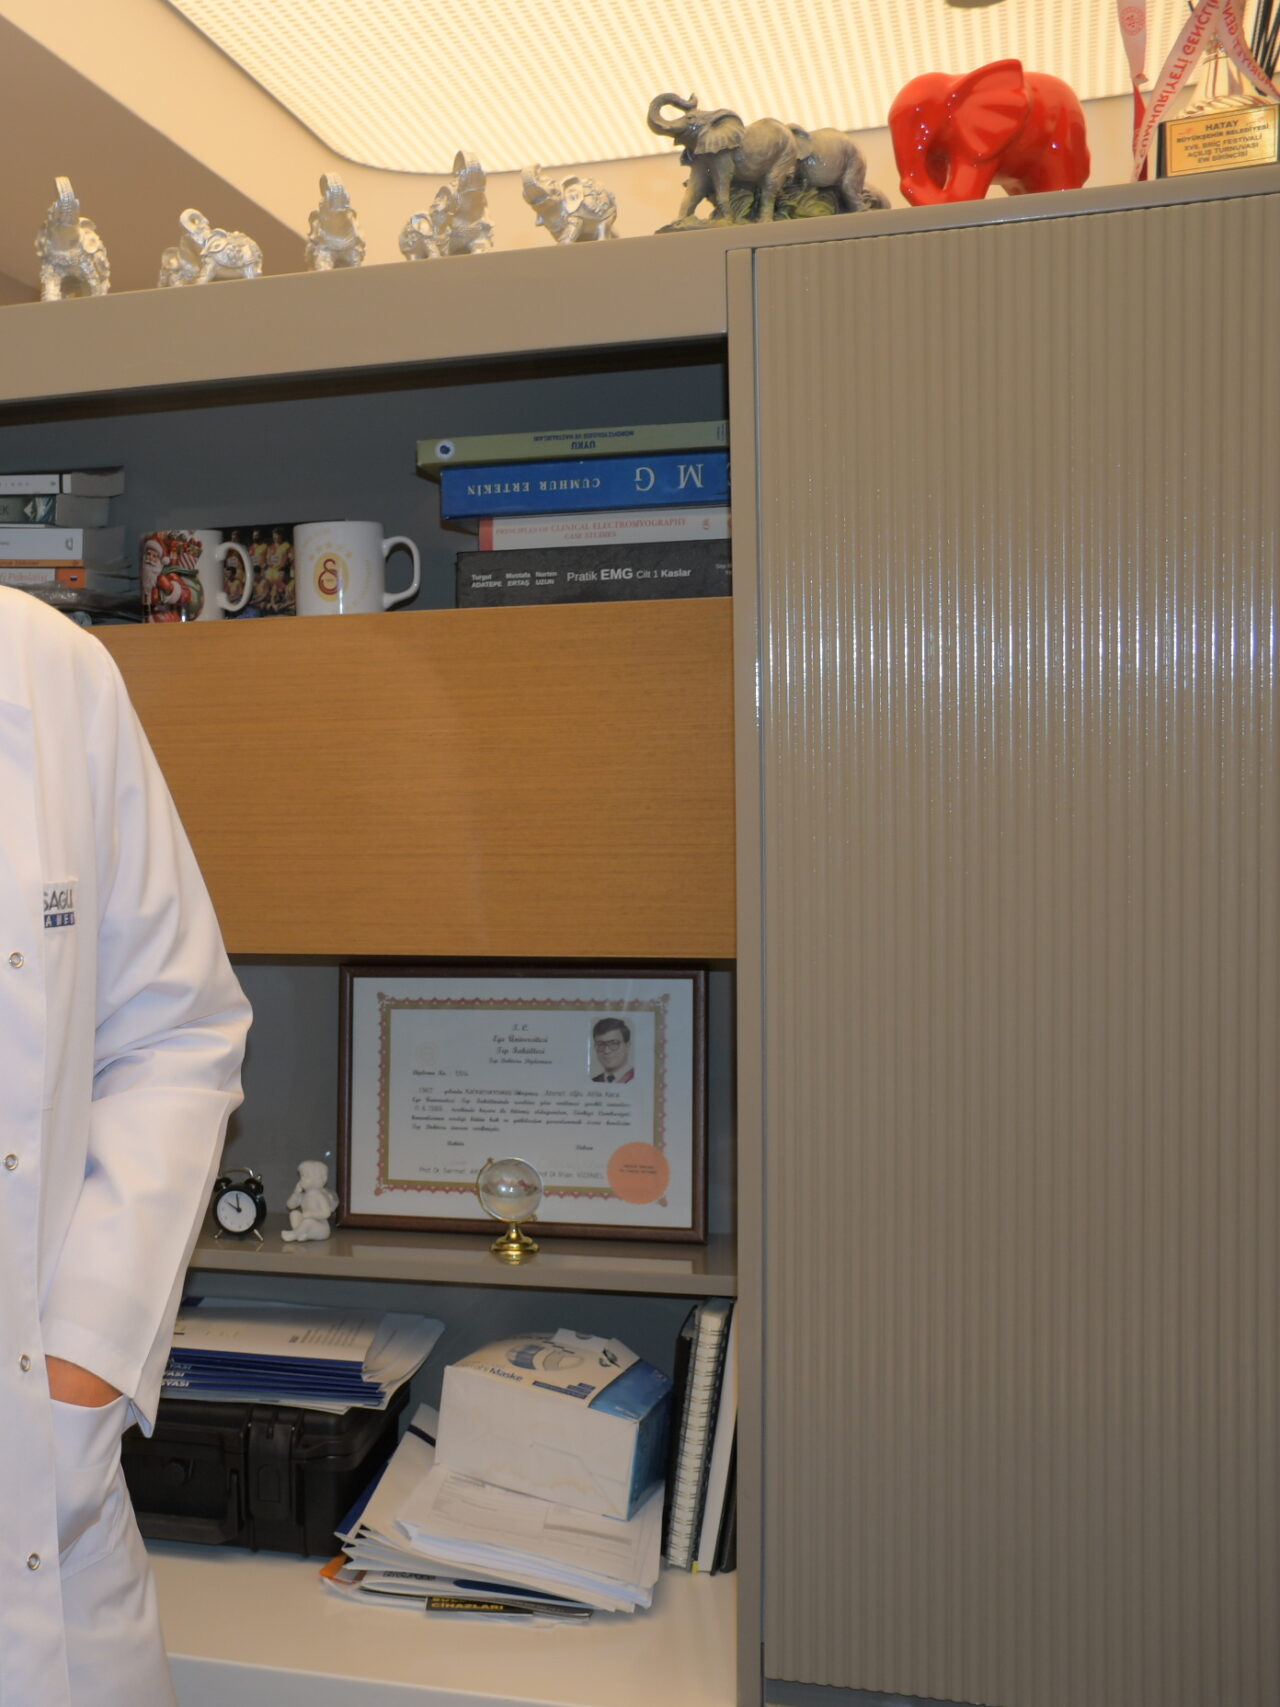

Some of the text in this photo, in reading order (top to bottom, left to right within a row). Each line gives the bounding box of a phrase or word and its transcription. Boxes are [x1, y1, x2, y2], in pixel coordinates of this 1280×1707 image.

[1205, 120, 1238, 131] HATAY
[570, 440, 596, 450] UYKU
[467, 463, 704, 496] M G CUMHUR ERTEKİN
[550, 522, 589, 533] CLINICAL
[592, 517, 687, 530] ELECTROMYOGRAPHY
[564, 531, 617, 540] CASE STUDIES
[505, 572, 531, 580] Mustafa
[567, 567, 692, 582] Pratik EMG Cilt 1 Kaslar
[471, 580, 502, 588] ADATEPE
[507, 579, 530, 587] ERTAŞ
